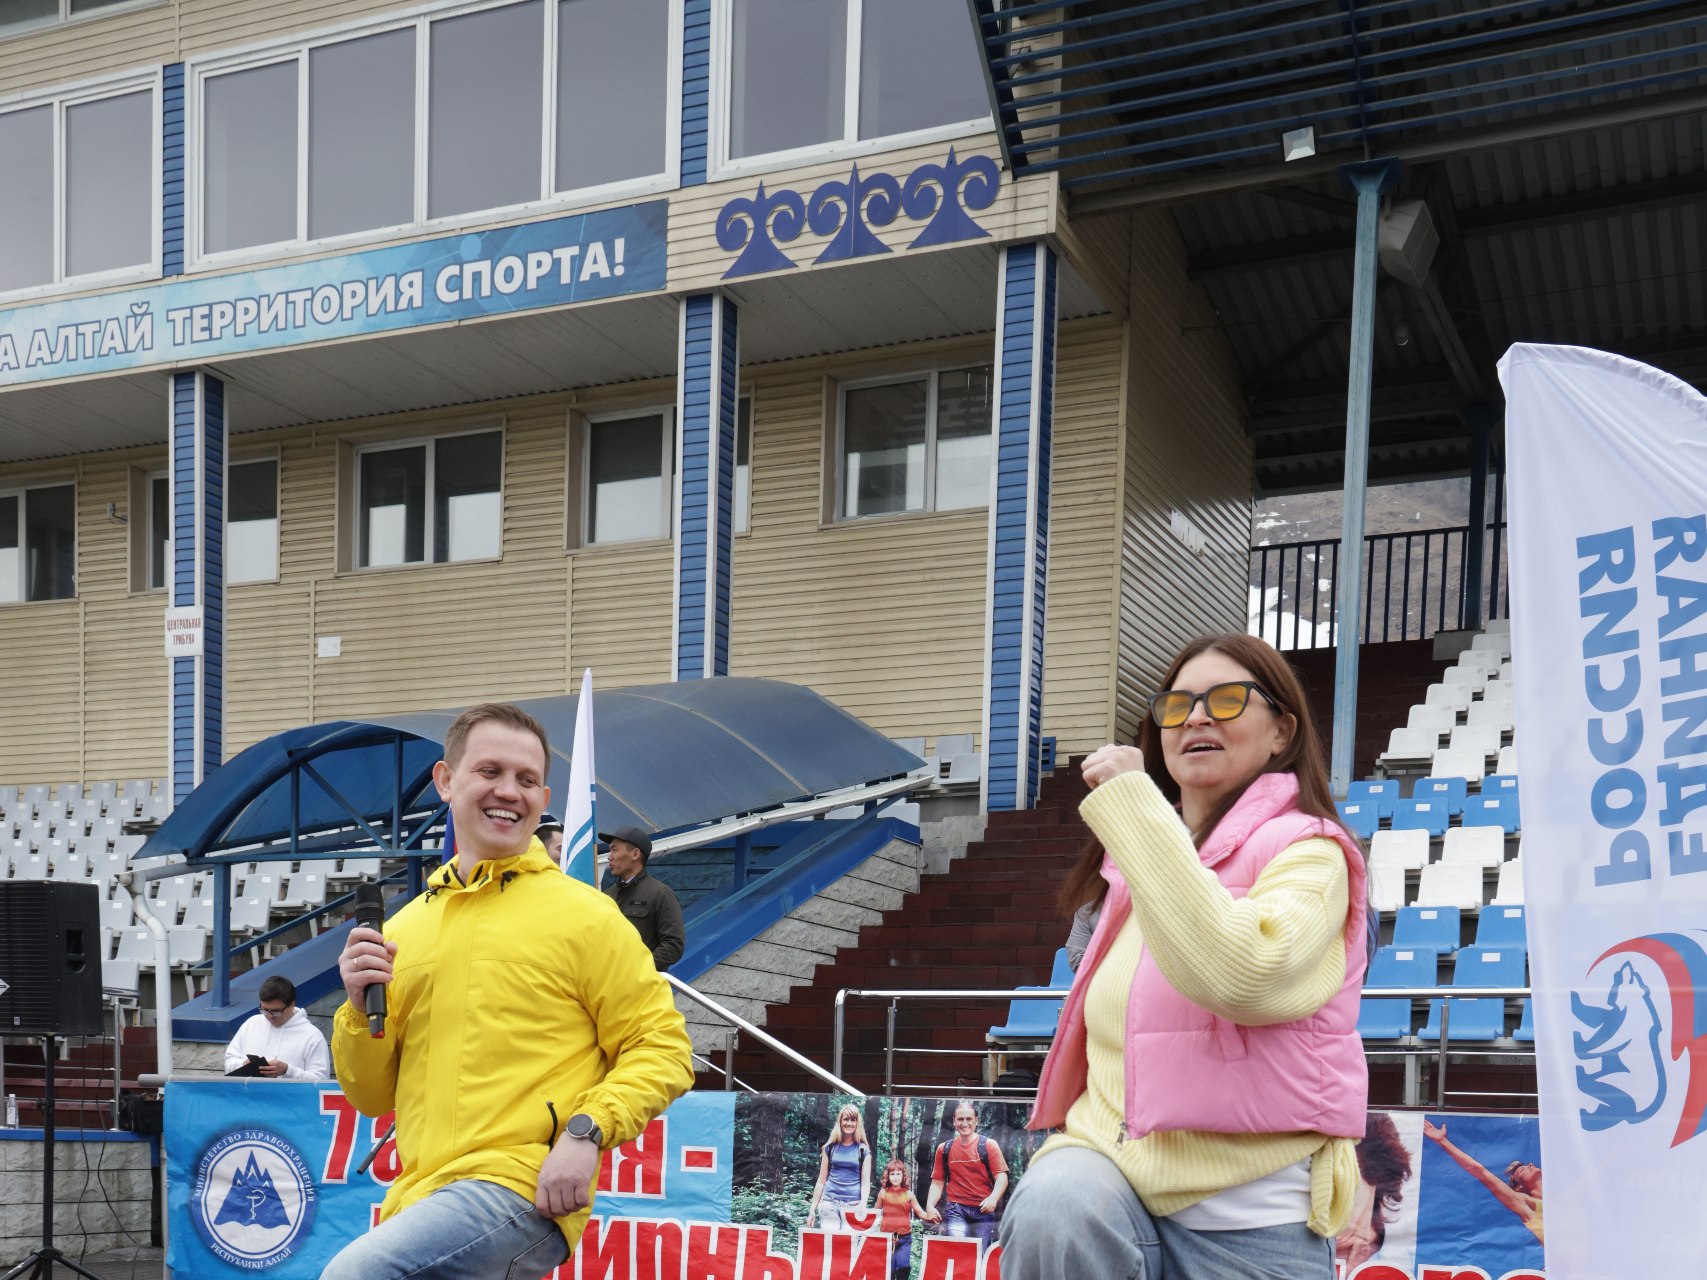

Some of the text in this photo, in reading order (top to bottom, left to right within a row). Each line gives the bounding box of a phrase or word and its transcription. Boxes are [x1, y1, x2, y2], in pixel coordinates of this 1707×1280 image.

[26, 301, 154, 368] АЛТАЙ
[166, 269, 424, 346] ТЕРРИТОРИЯ
[435, 237, 626, 304] СПОРТА!
[166, 617, 201, 632] ЦЕНТРАЛЬНАЯ
[173, 634, 195, 645] ТРИБУНА
[195, 1133, 242, 1197] МИНИСТЕРСТВО
[244, 1131, 315, 1202] ЗДРАВООХРАНЕНИЯ
[210, 1242, 292, 1269] РЕСПУБЛИКИ АЛТАЙ
